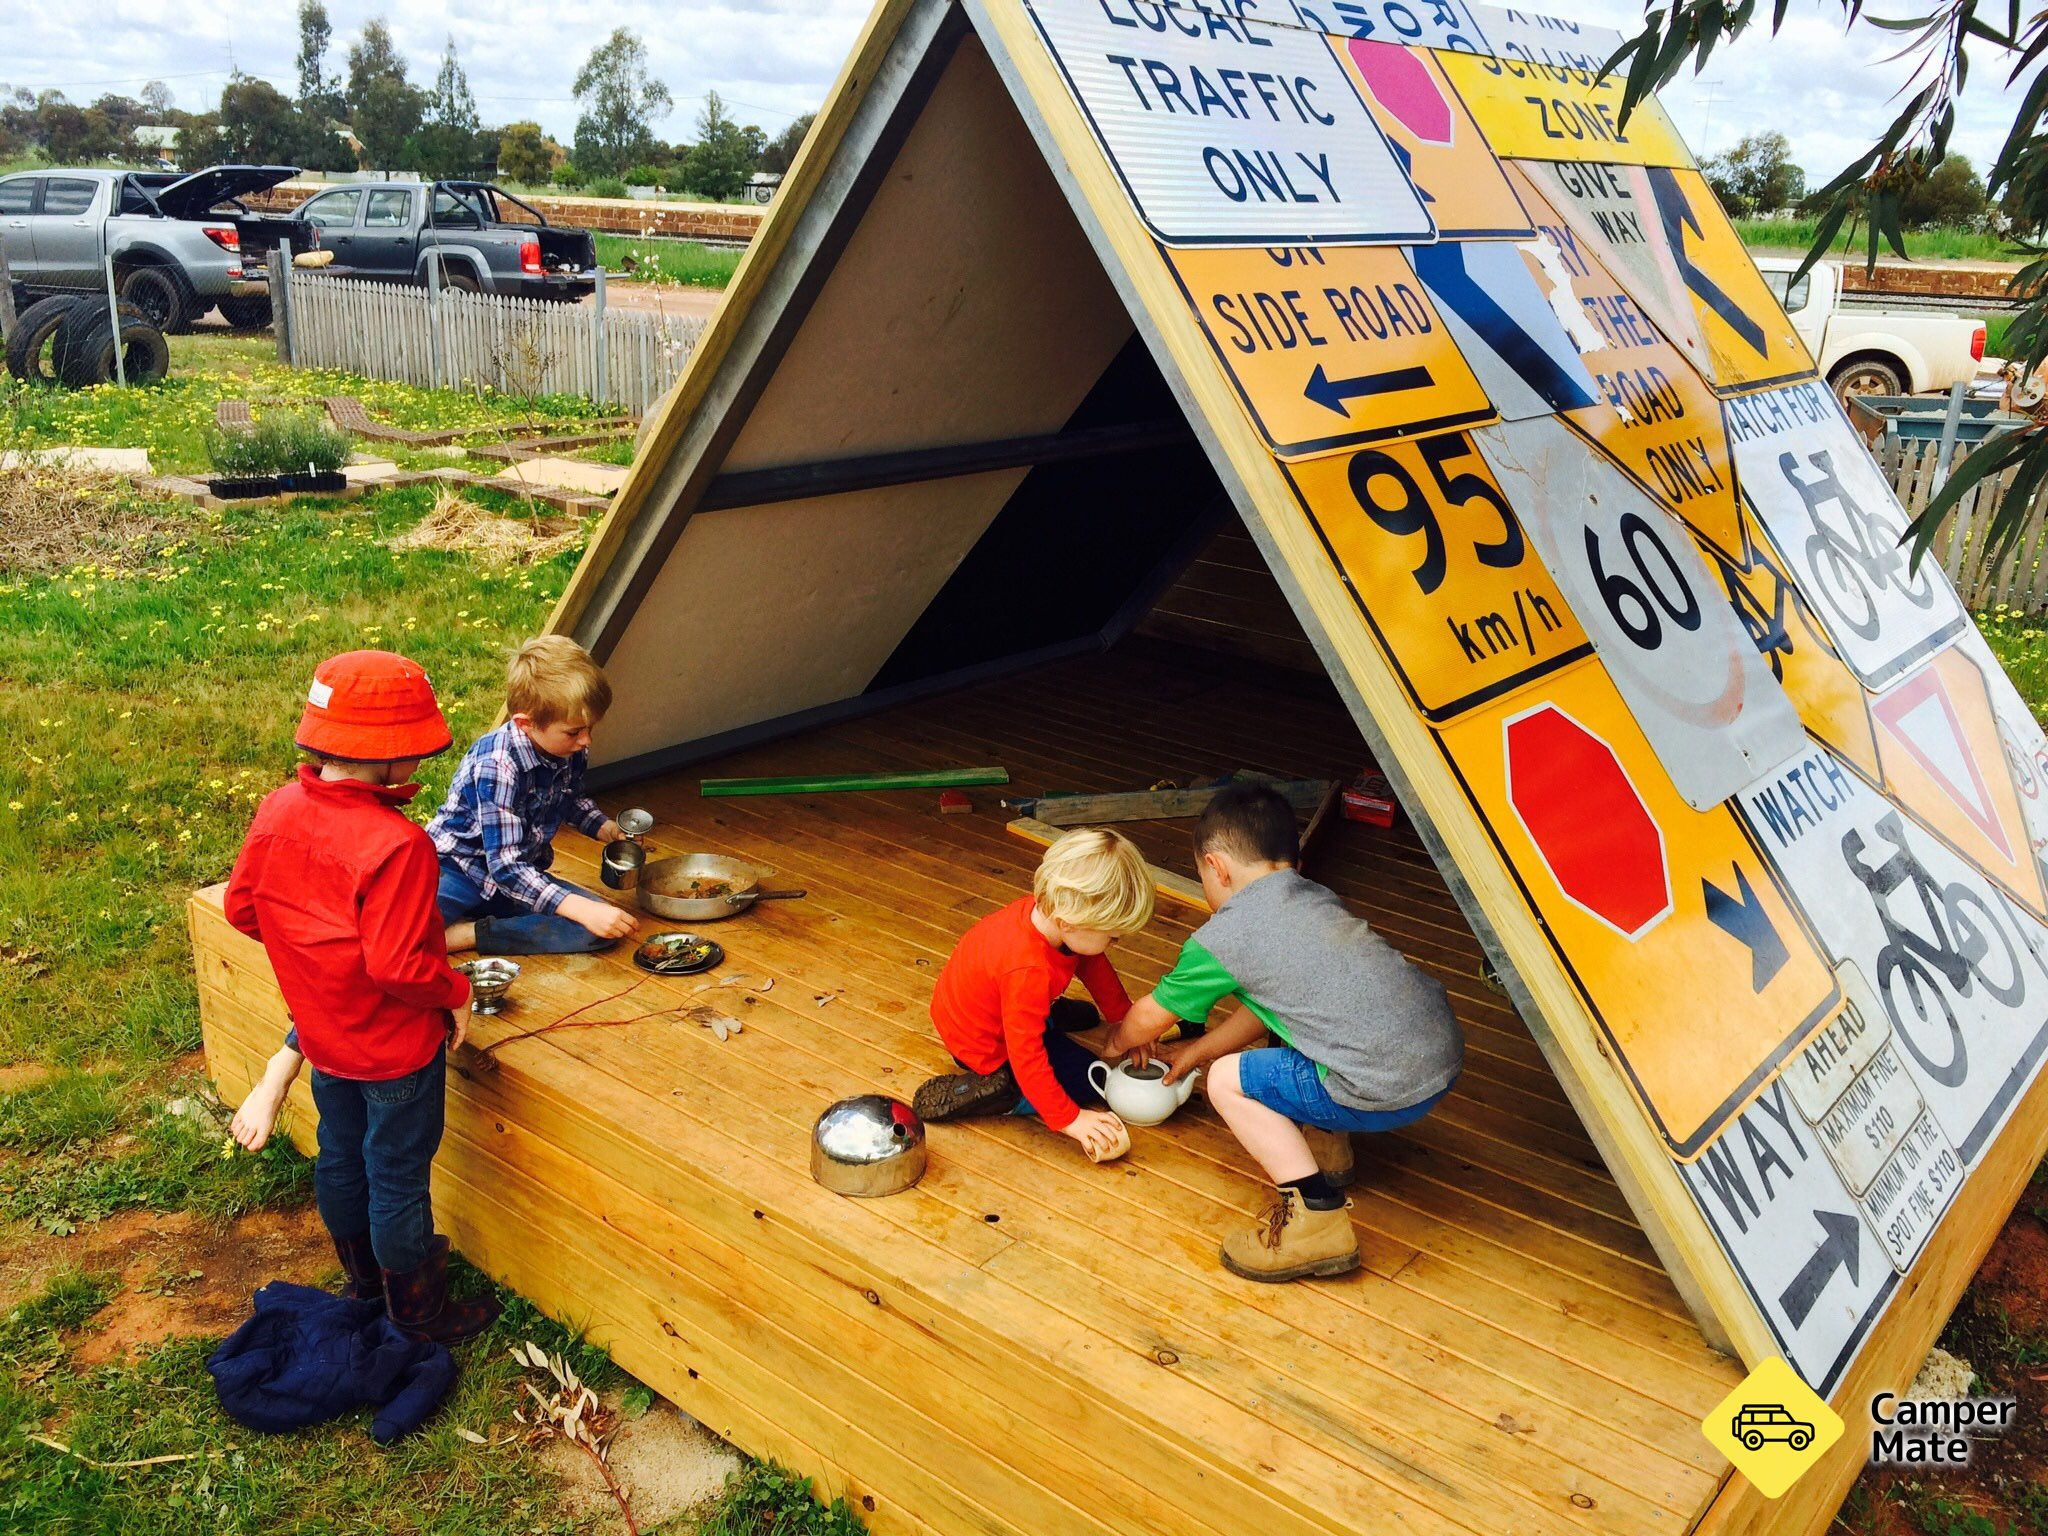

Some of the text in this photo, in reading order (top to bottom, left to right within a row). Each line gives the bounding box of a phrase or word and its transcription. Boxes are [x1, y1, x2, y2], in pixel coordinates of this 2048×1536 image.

[1107, 55, 1335, 127] TRAFFIC
[1525, 96, 1629, 143] ZONE
[1202, 146, 1342, 204] ONLY
[1554, 162, 1632, 199] GIVE
[1591, 211, 1646, 244] WAY
[1212, 283, 1433, 355] SIDE ROAD
[1595, 366, 1685, 429] ROAD
[1780, 383, 1831, 426] FOR
[1646, 436, 1725, 504] ONLY
[1347, 430, 1526, 596] 95
[1583, 512, 1702, 651] 60
[1446, 588, 1562, 665] km/h
[1751, 751, 1855, 848] WATCH
[1802, 998, 1867, 1084] AHEAD
[1822, 1049, 1899, 1149] MAXIMUM FINE
[1864, 1105, 1896, 1149] $110
[1695, 1078, 1809, 1235] WAY
[1866, 1114, 1938, 1223] MINIMUM ON THE
[1886, 1149, 1957, 1256] SPOT FINE $110
